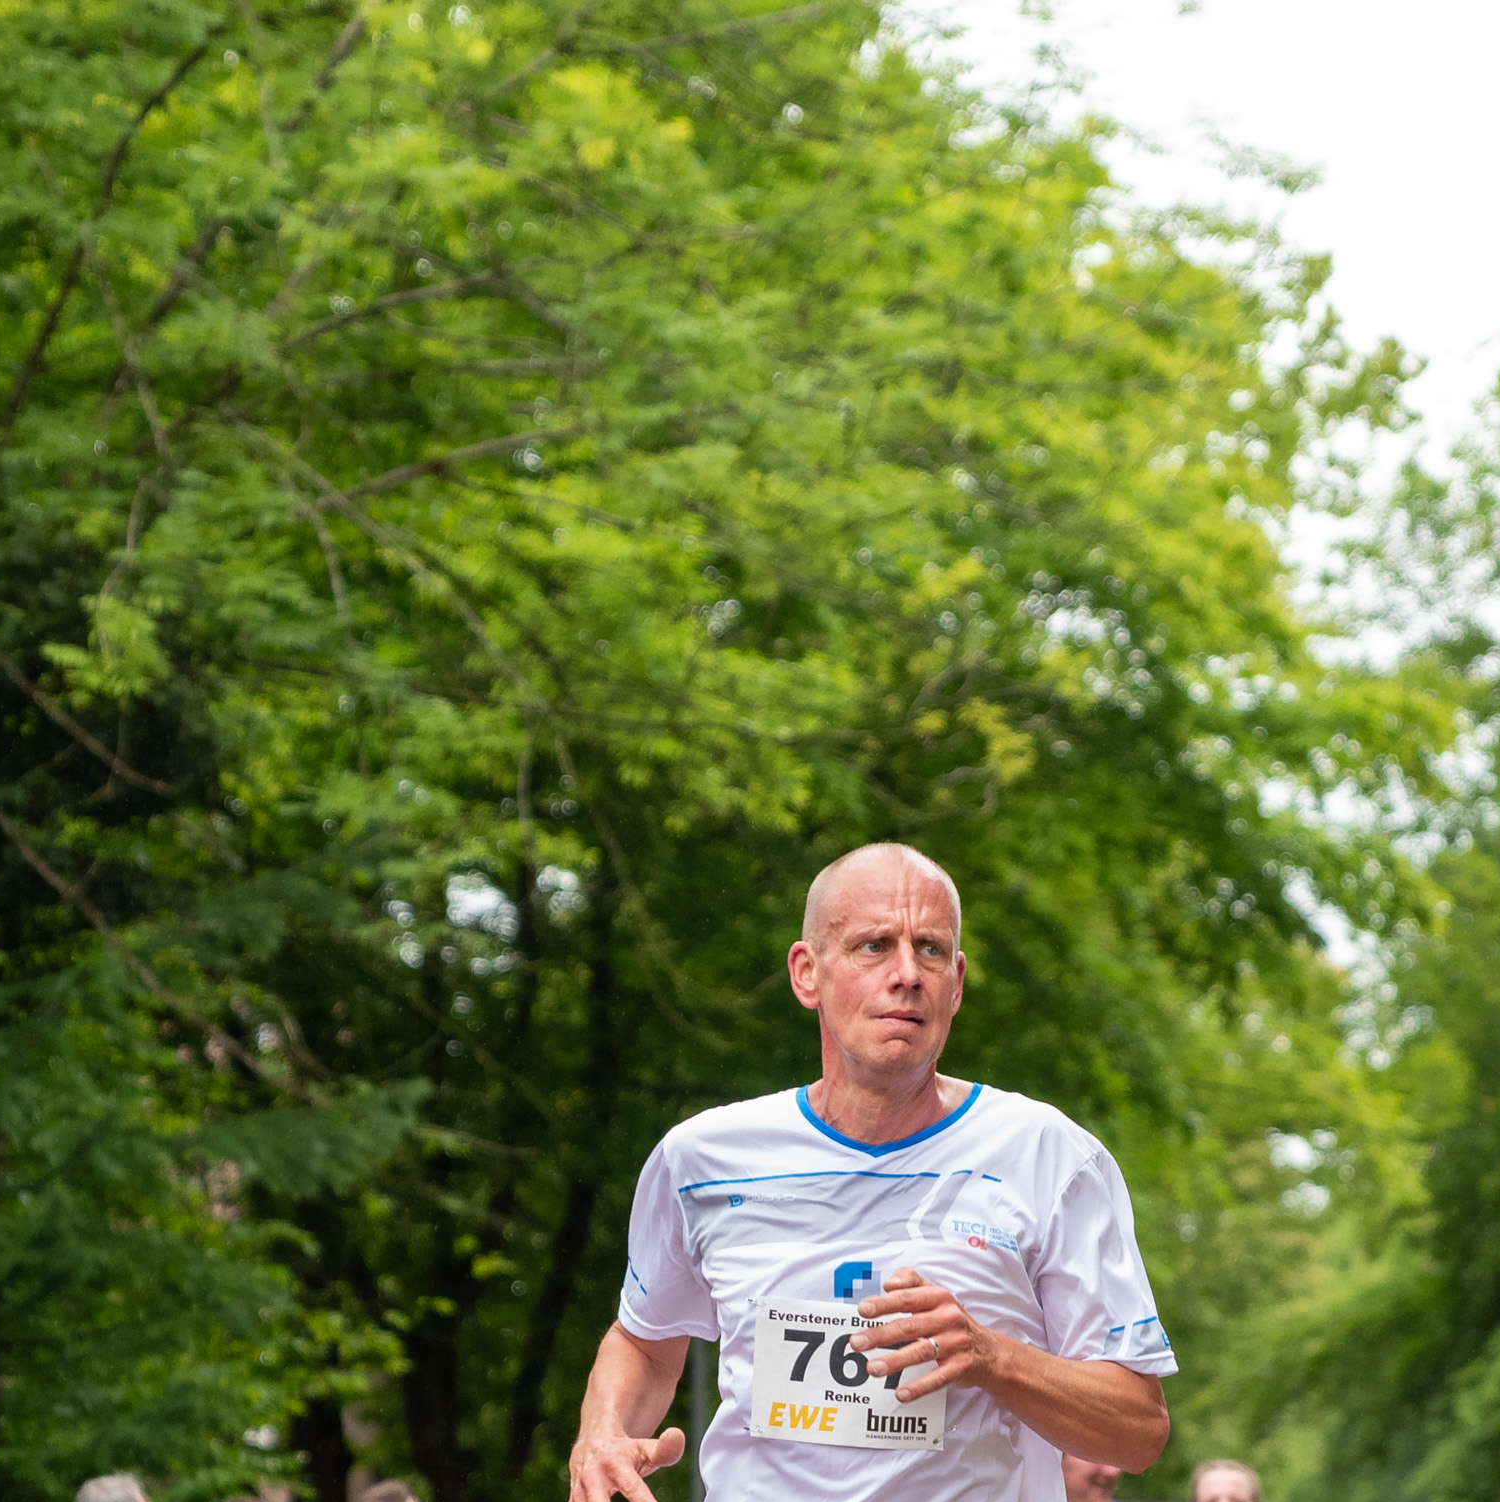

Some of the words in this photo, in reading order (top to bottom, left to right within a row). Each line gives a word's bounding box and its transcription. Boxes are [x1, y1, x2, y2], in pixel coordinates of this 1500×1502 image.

[768, 1309, 847, 1327] Everstener
[824, 1390, 871, 1405] Renke
[768, 1402, 838, 1432] EWE
[866, 1408, 928, 1434] bruns
